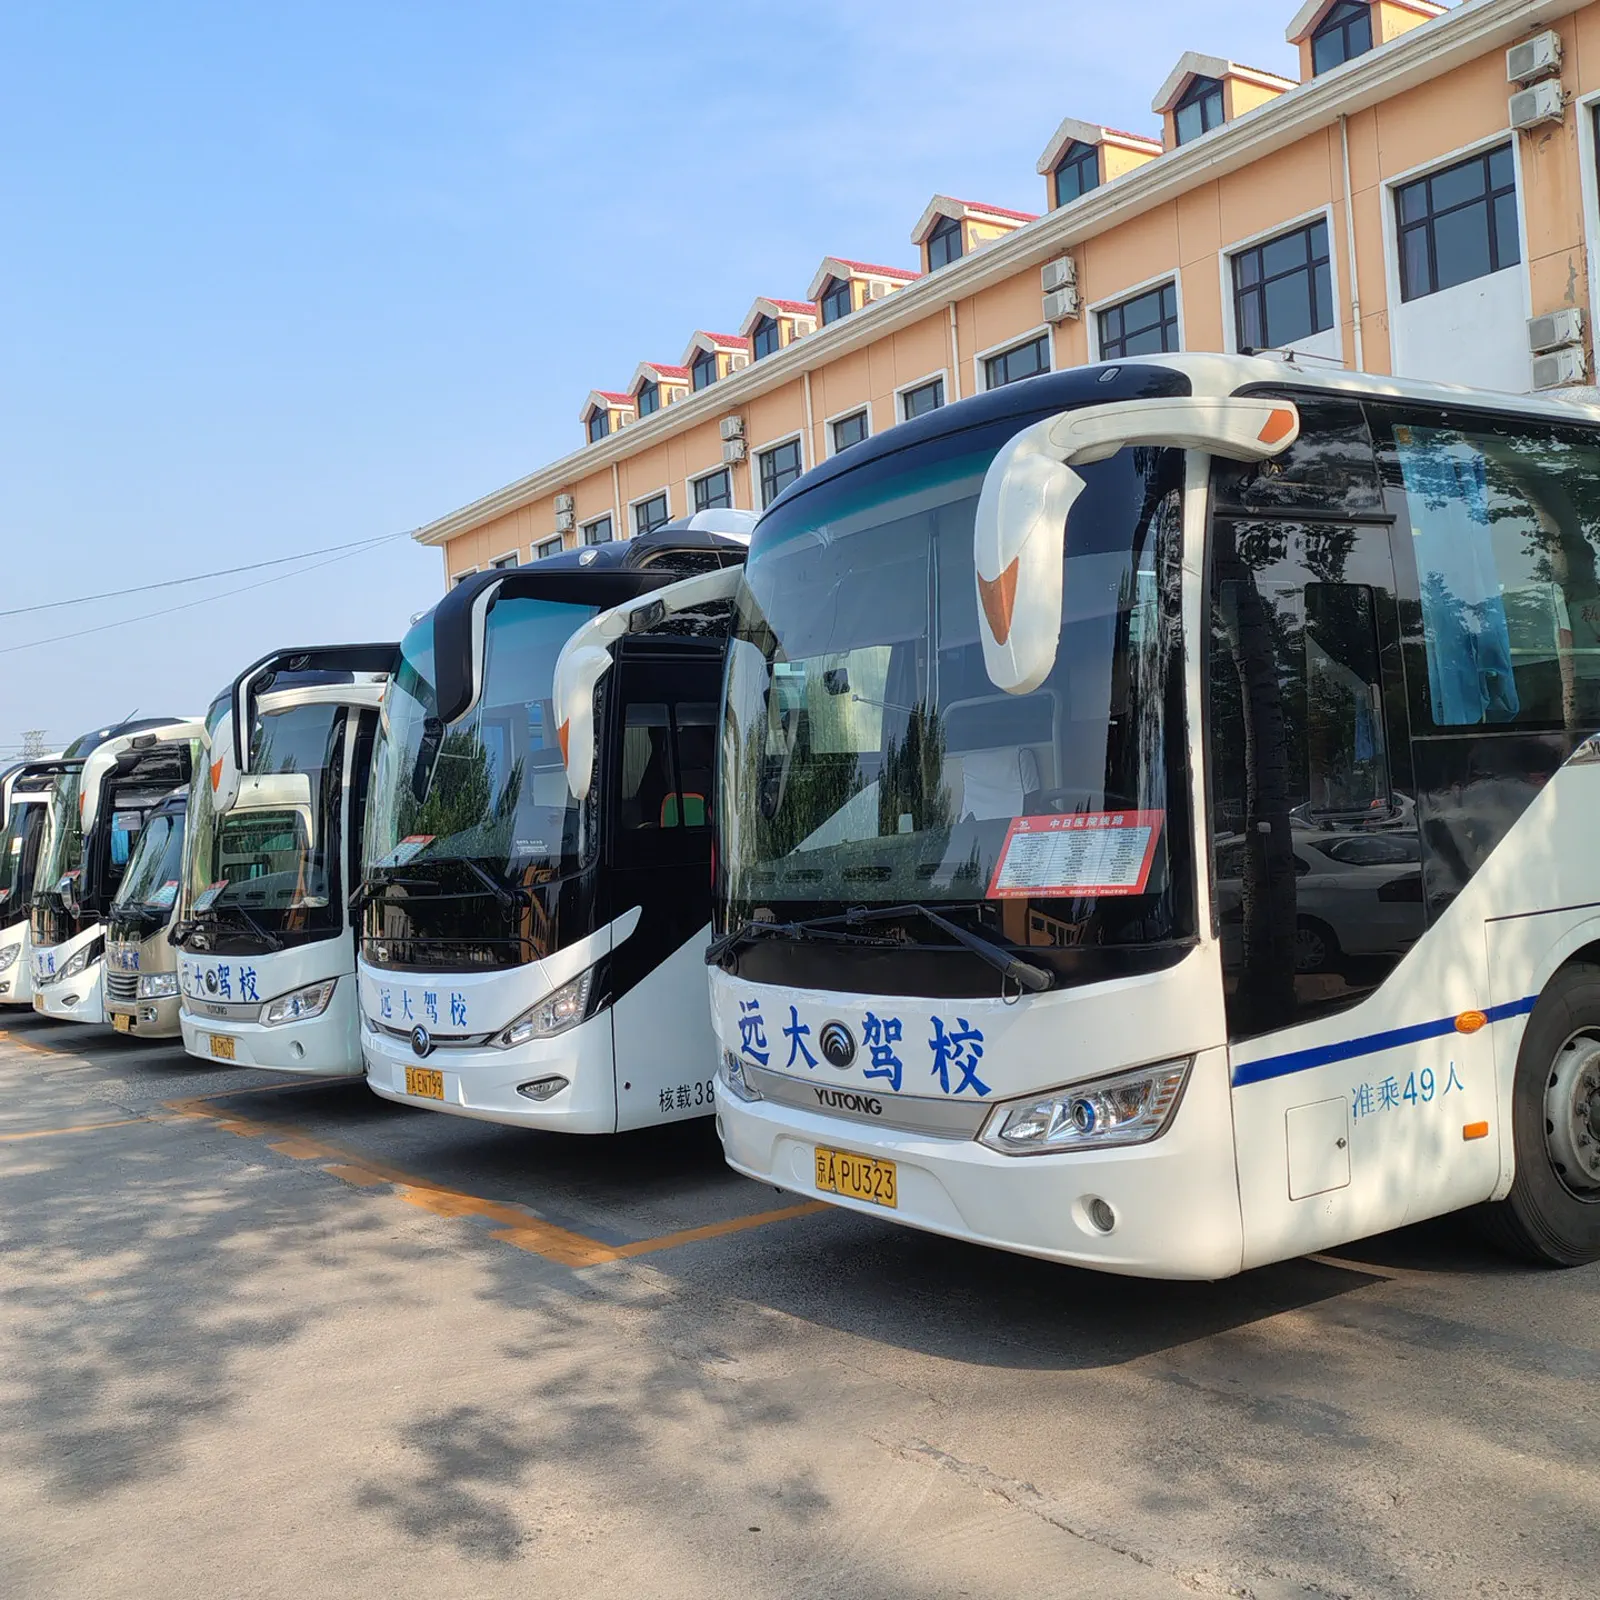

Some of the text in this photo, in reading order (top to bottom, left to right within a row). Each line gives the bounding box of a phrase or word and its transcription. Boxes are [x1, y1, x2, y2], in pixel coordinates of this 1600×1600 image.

[380, 988, 467, 1027] 远大驾校
[738, 998, 992, 1097] 远大驾校
[659, 1079, 715, 1113] 核载38
[814, 1087, 883, 1116] YUTONG
[1351, 1061, 1464, 1118] 准乘49人
